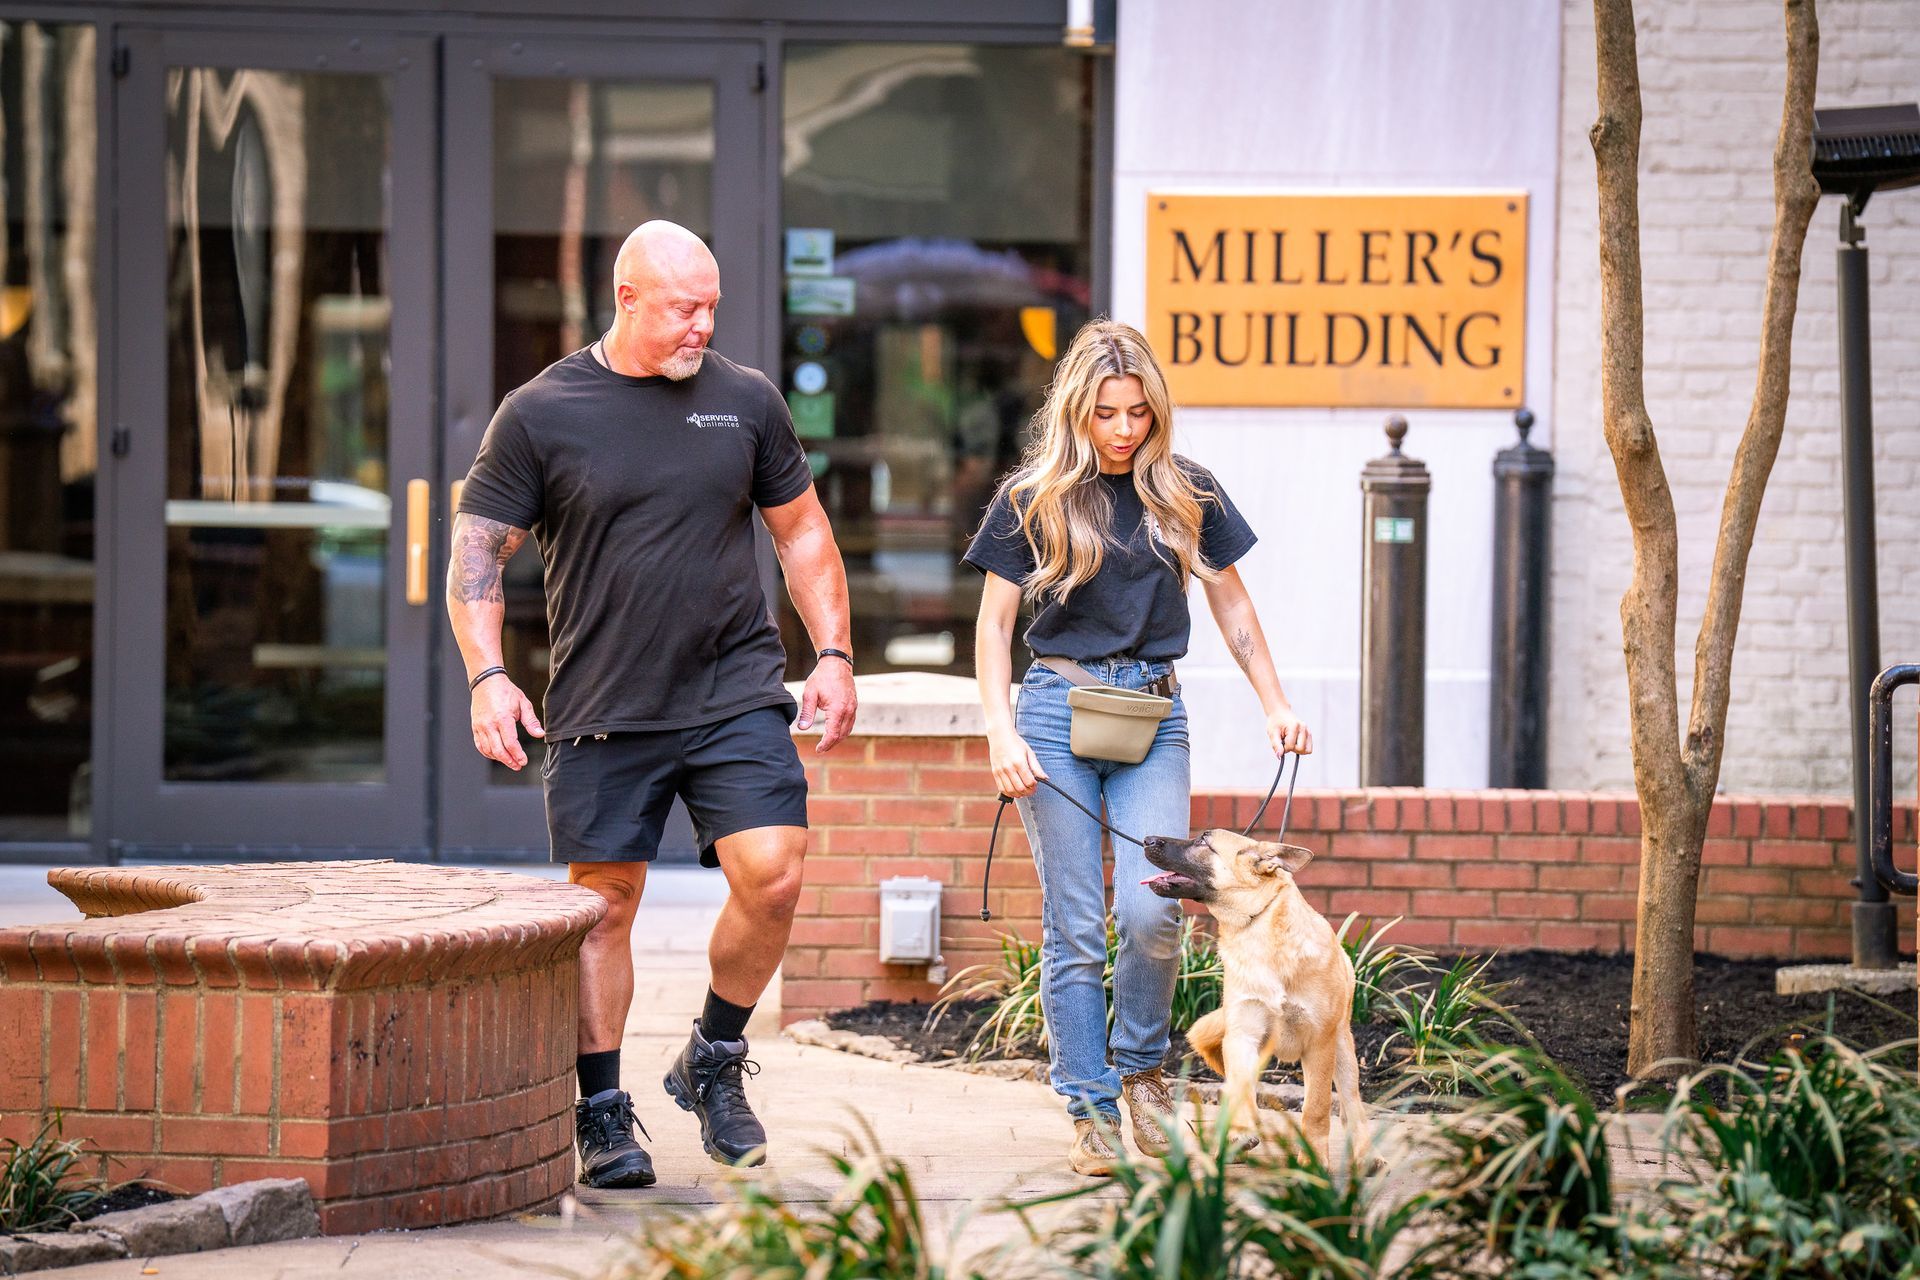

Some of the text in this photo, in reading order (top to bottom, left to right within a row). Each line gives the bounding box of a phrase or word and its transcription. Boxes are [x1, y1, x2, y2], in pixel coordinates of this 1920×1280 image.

[1170, 229, 1504, 287] MILLER'S
[1169, 311, 1502, 369] BUILDING
[700, 414, 739, 422] SERVICES
